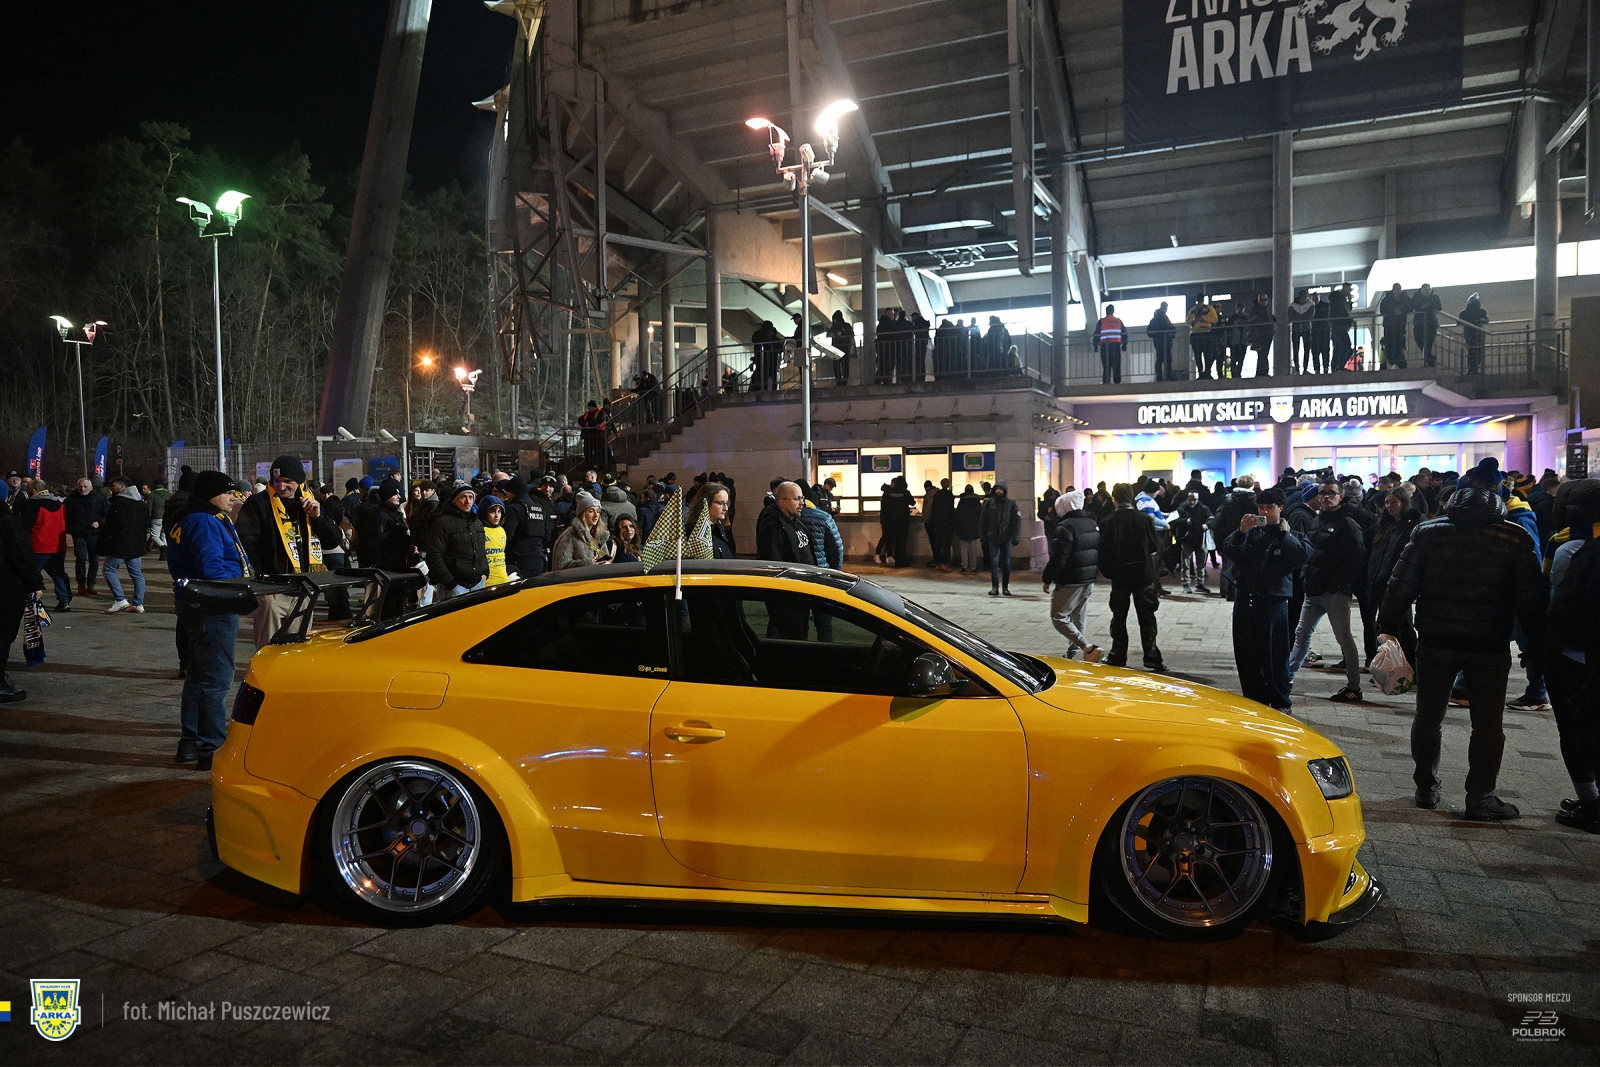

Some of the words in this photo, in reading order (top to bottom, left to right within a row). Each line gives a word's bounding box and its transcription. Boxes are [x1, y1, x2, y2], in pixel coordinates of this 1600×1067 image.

[1166, 6, 1312, 94] ARKA
[1138, 402, 1213, 424] OFICJALNY
[1216, 400, 1264, 422] SKLEP
[1299, 397, 1343, 418] ARKA
[1346, 395, 1408, 416] GDYNIA
